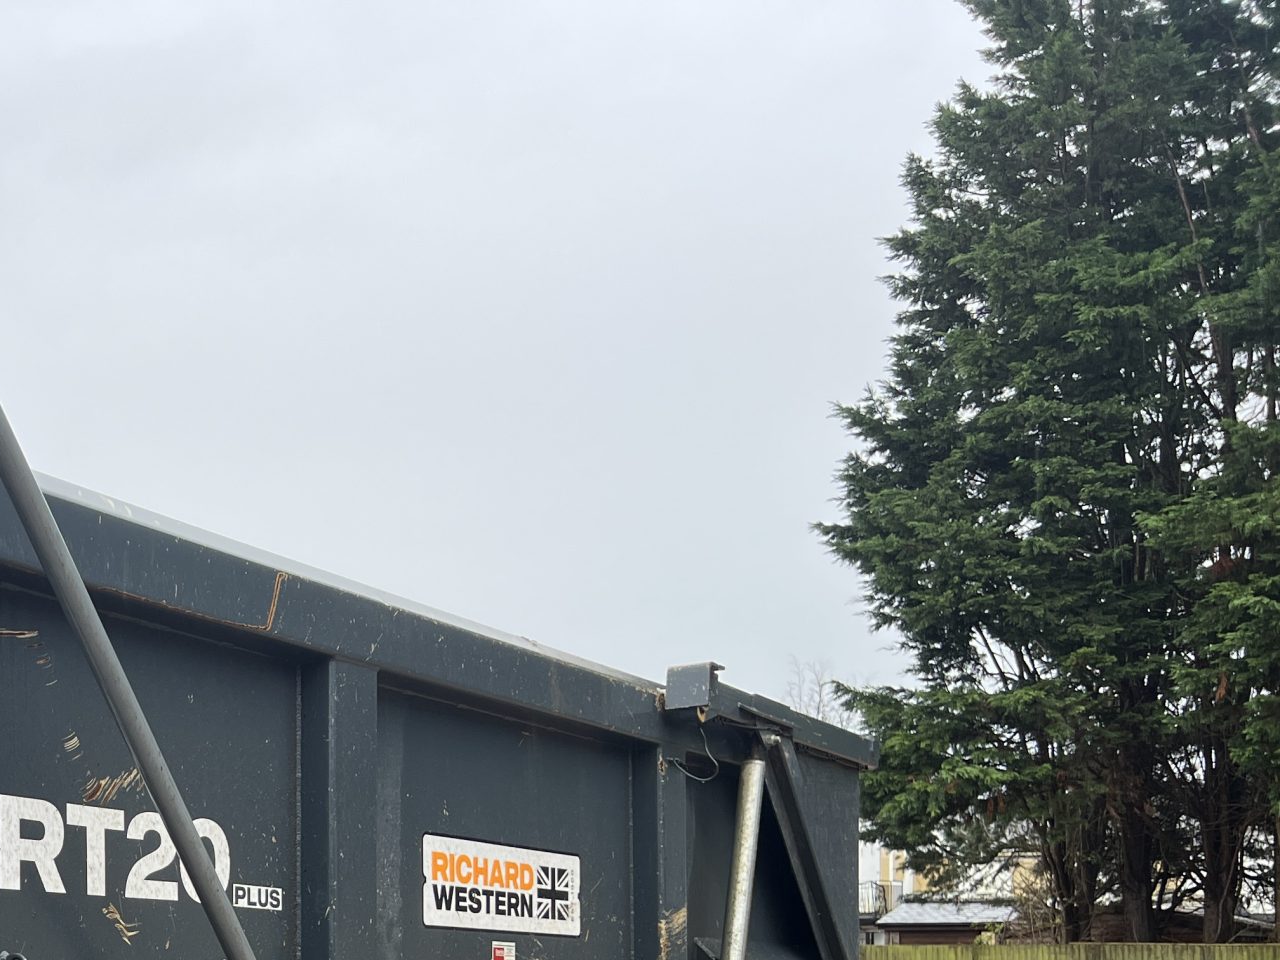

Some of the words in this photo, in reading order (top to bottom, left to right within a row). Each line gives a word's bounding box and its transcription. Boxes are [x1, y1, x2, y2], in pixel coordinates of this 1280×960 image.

[431, 851, 534, 891] RICHARD
[234, 886, 281, 909] PLUS
[433, 884, 533, 918] WESTERN
